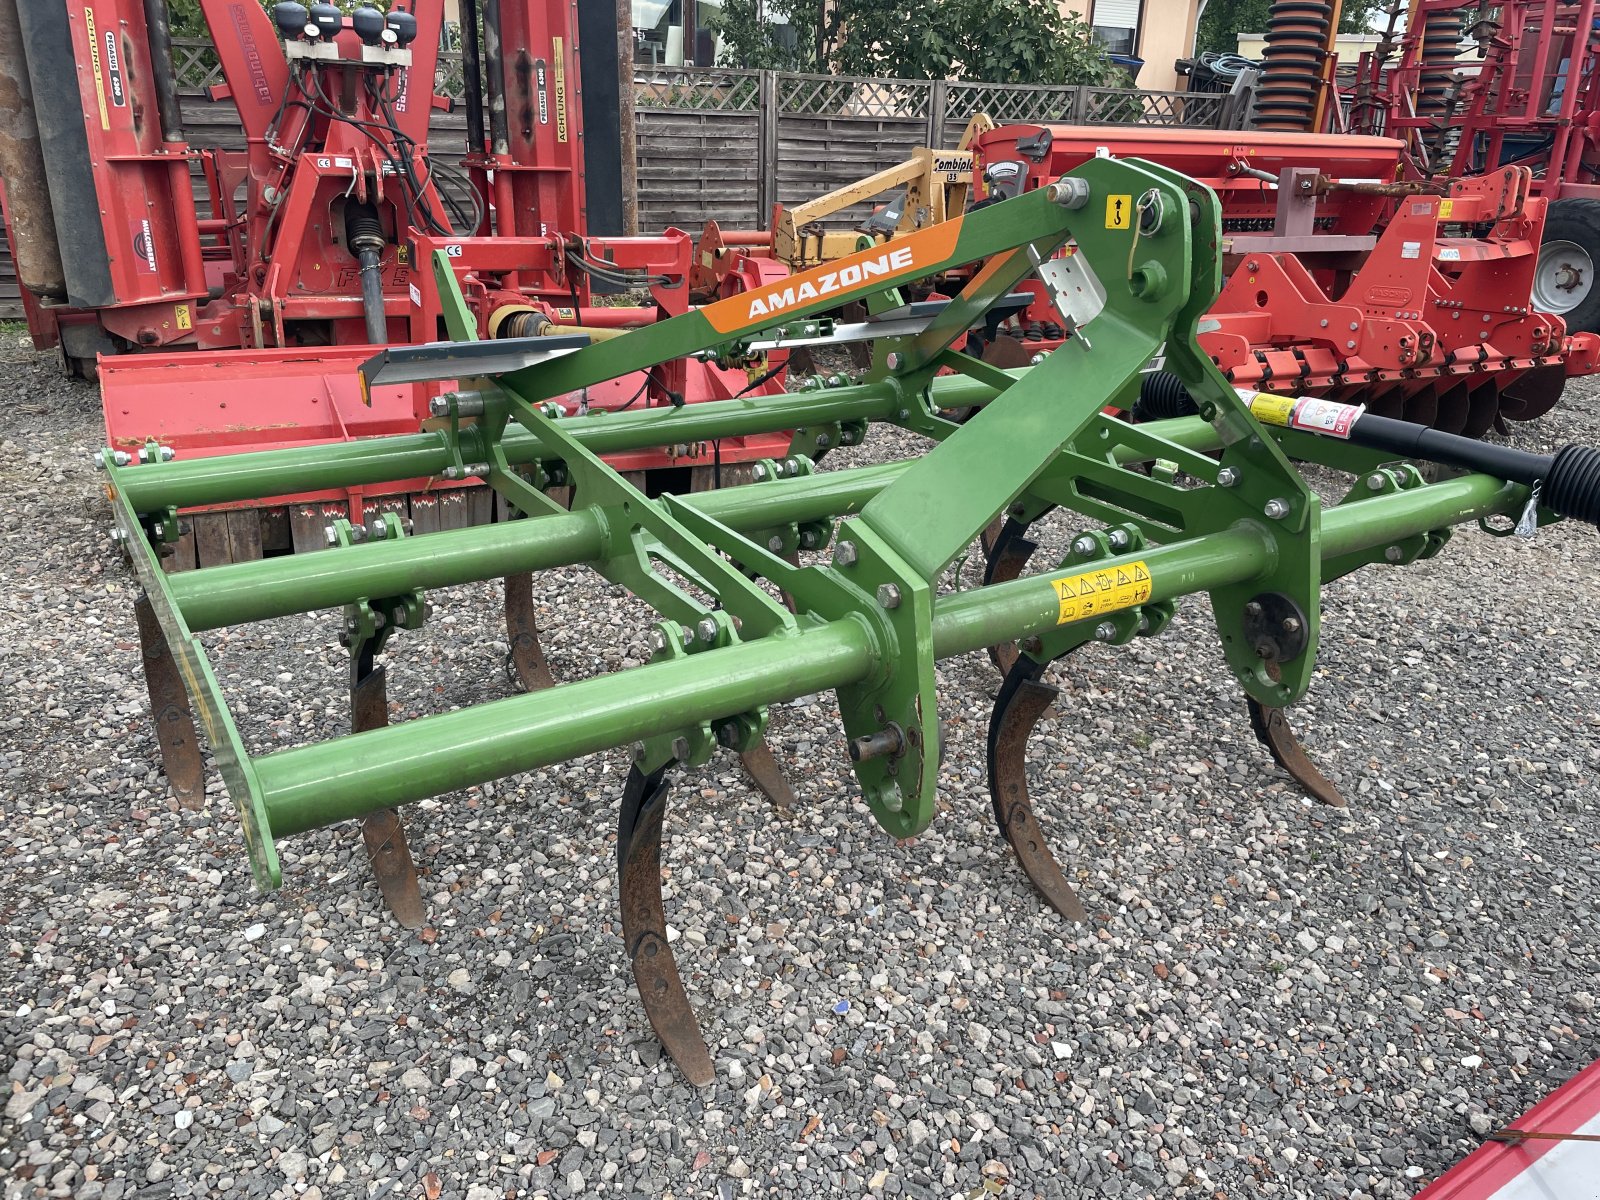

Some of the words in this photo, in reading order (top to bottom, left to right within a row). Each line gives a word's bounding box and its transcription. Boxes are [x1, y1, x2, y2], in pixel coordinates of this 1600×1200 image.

[86, 9, 100, 73] ACHTUNG
[107, 34, 117, 69] PEGASUS
[557, 87, 566, 141] ACHTUNG
[446, 246, 461, 256] CE
[748, 246, 913, 319] AMAZONE
